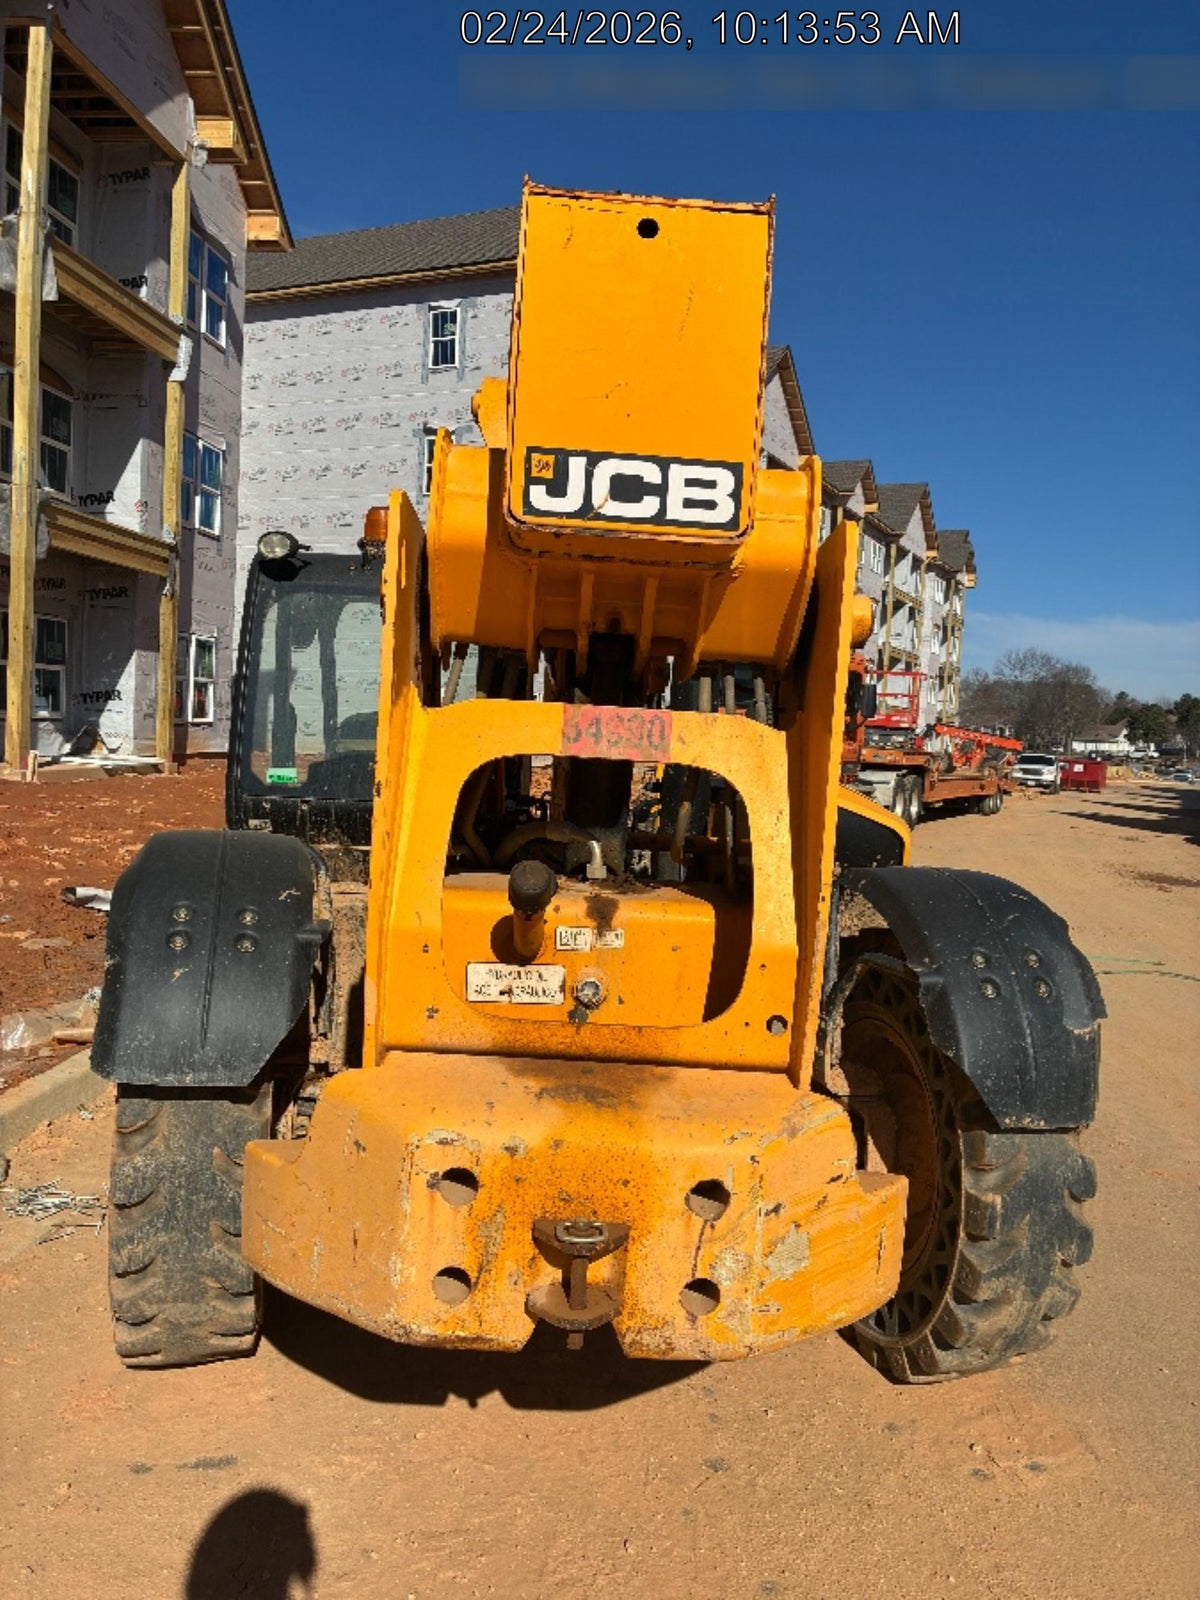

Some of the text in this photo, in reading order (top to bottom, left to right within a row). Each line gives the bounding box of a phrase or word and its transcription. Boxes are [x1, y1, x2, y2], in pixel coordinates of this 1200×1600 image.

[108, 167, 151, 185] TYPAR
[529, 456, 735, 523] JCB
[85, 586, 129, 601] TYPAR
[80, 689, 123, 704] TYPAR
